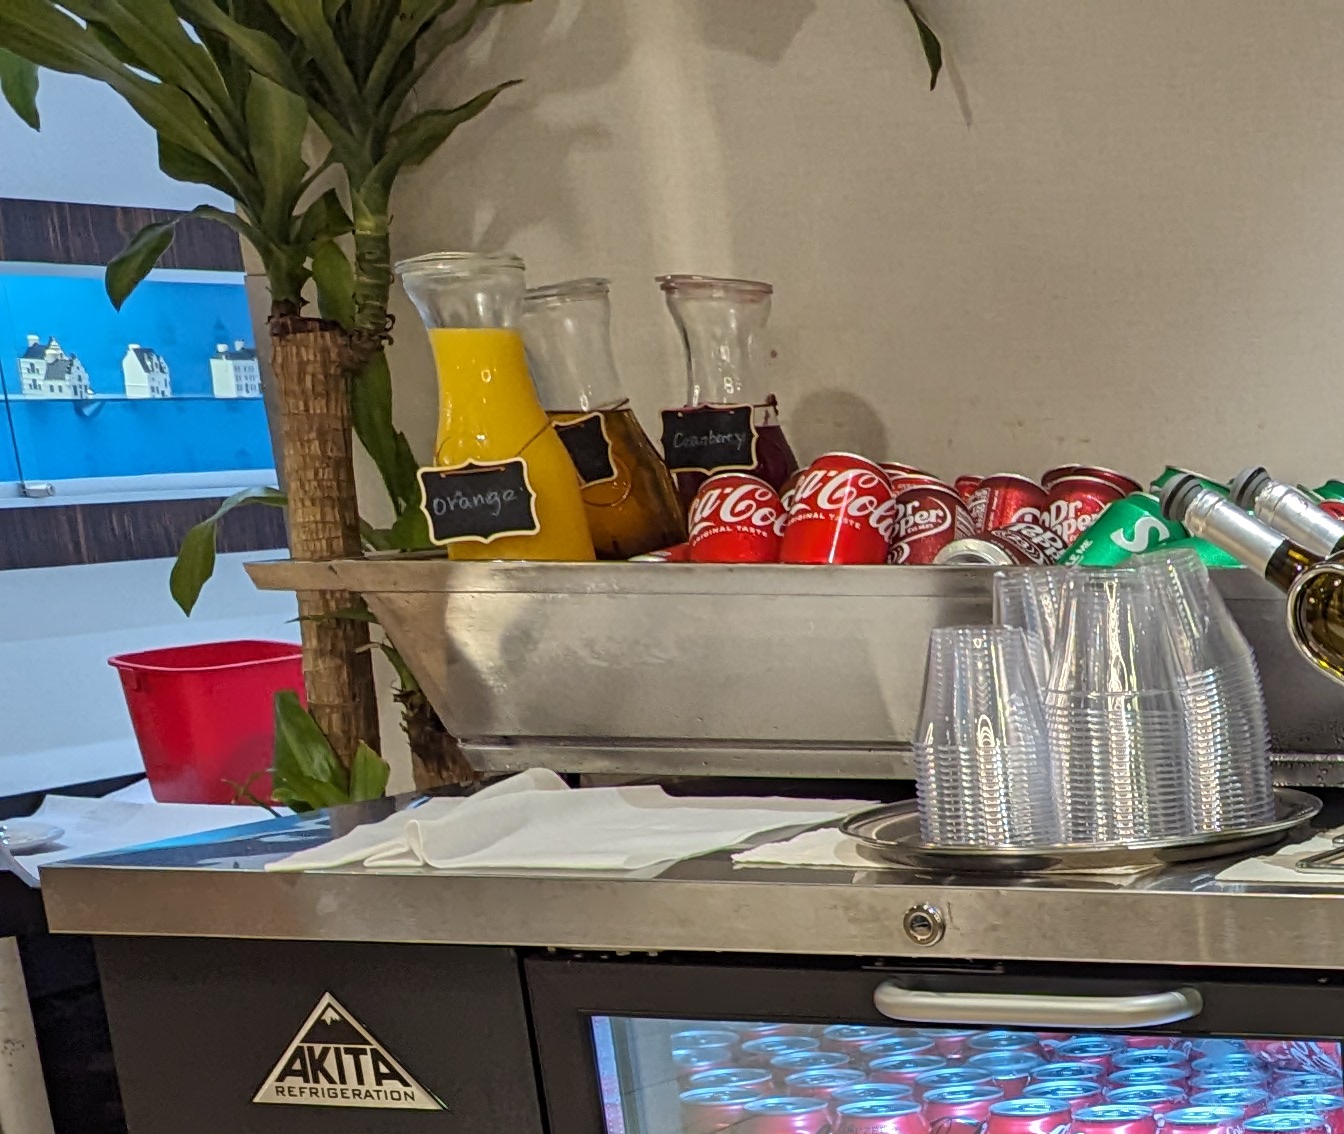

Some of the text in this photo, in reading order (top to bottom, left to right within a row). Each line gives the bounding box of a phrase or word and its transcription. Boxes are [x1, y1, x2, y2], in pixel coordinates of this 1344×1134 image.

[736, 525, 768, 538] TASTE
[275, 1045, 413, 1088] AKITA
[275, 1085, 416, 1102] REFRIGERATION
